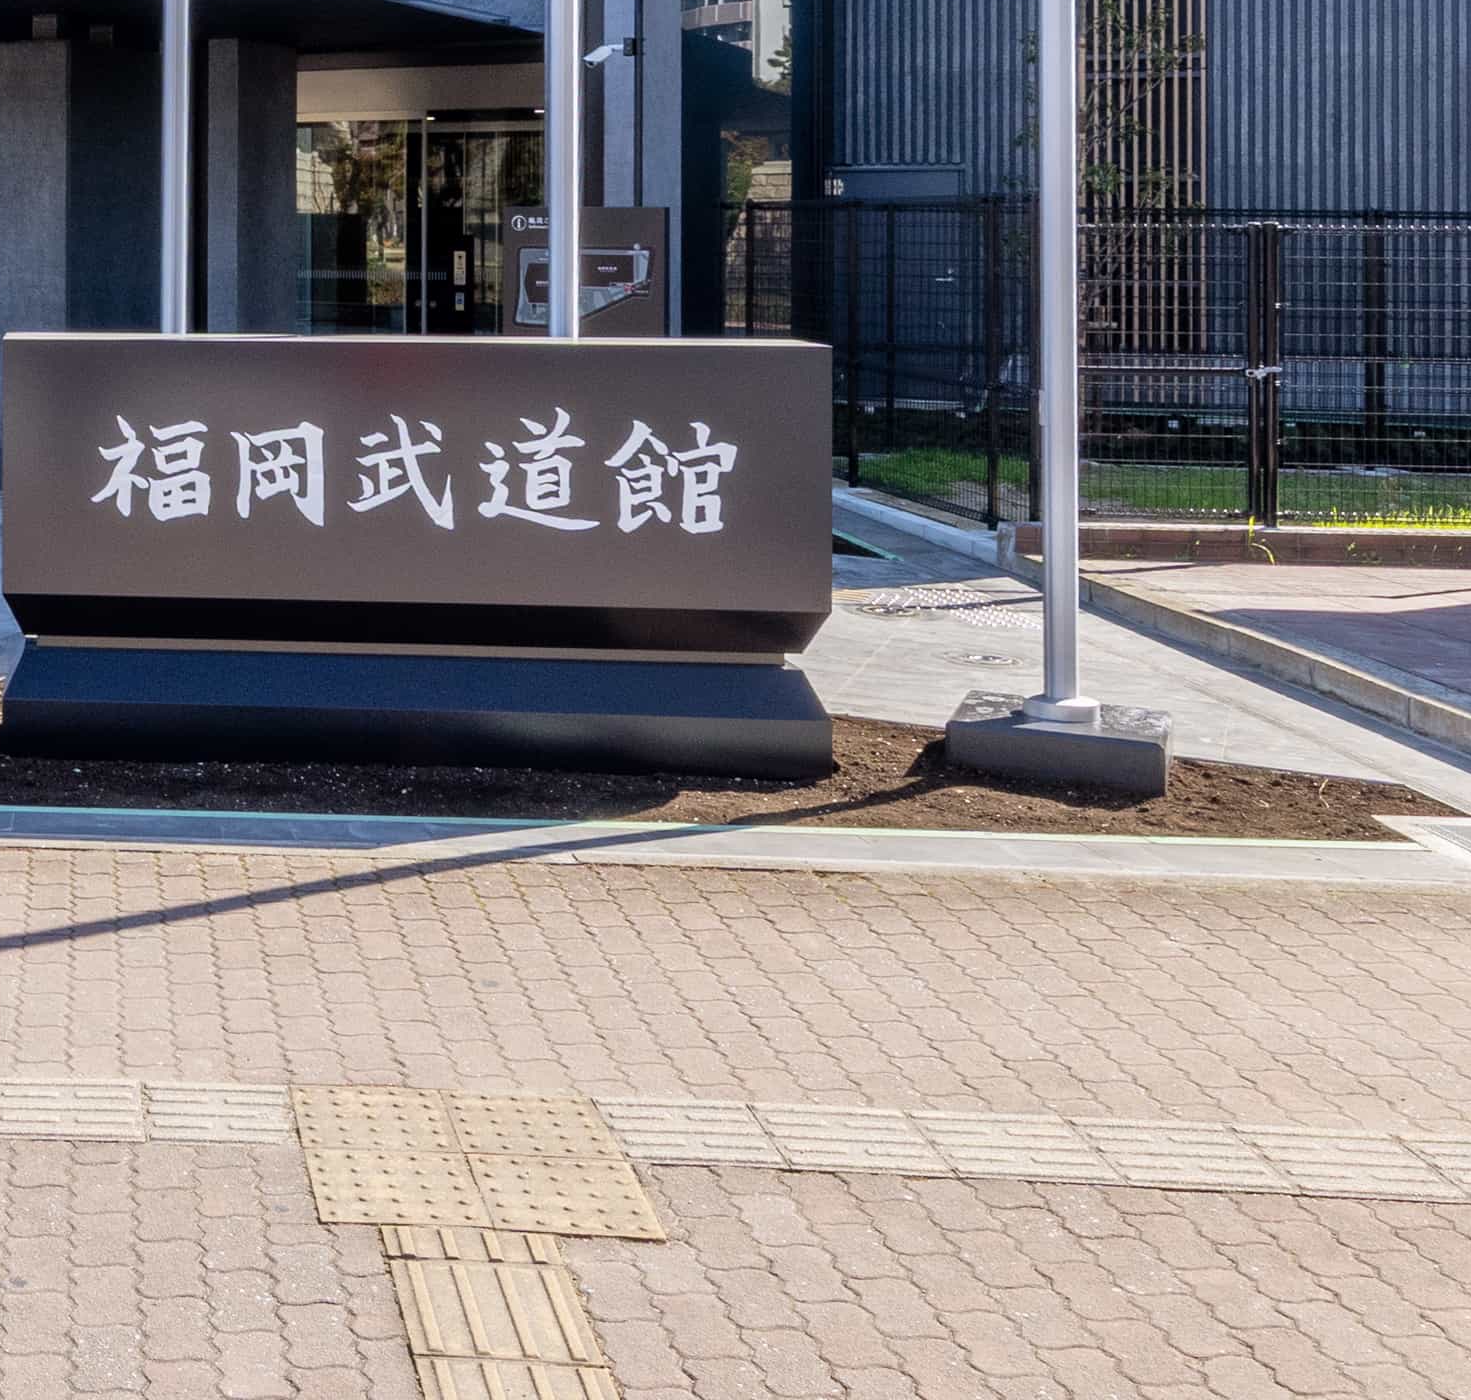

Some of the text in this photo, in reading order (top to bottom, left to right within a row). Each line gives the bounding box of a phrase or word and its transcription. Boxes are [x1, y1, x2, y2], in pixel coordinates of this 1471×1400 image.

[90, 406, 739, 535] 福岡武道館
